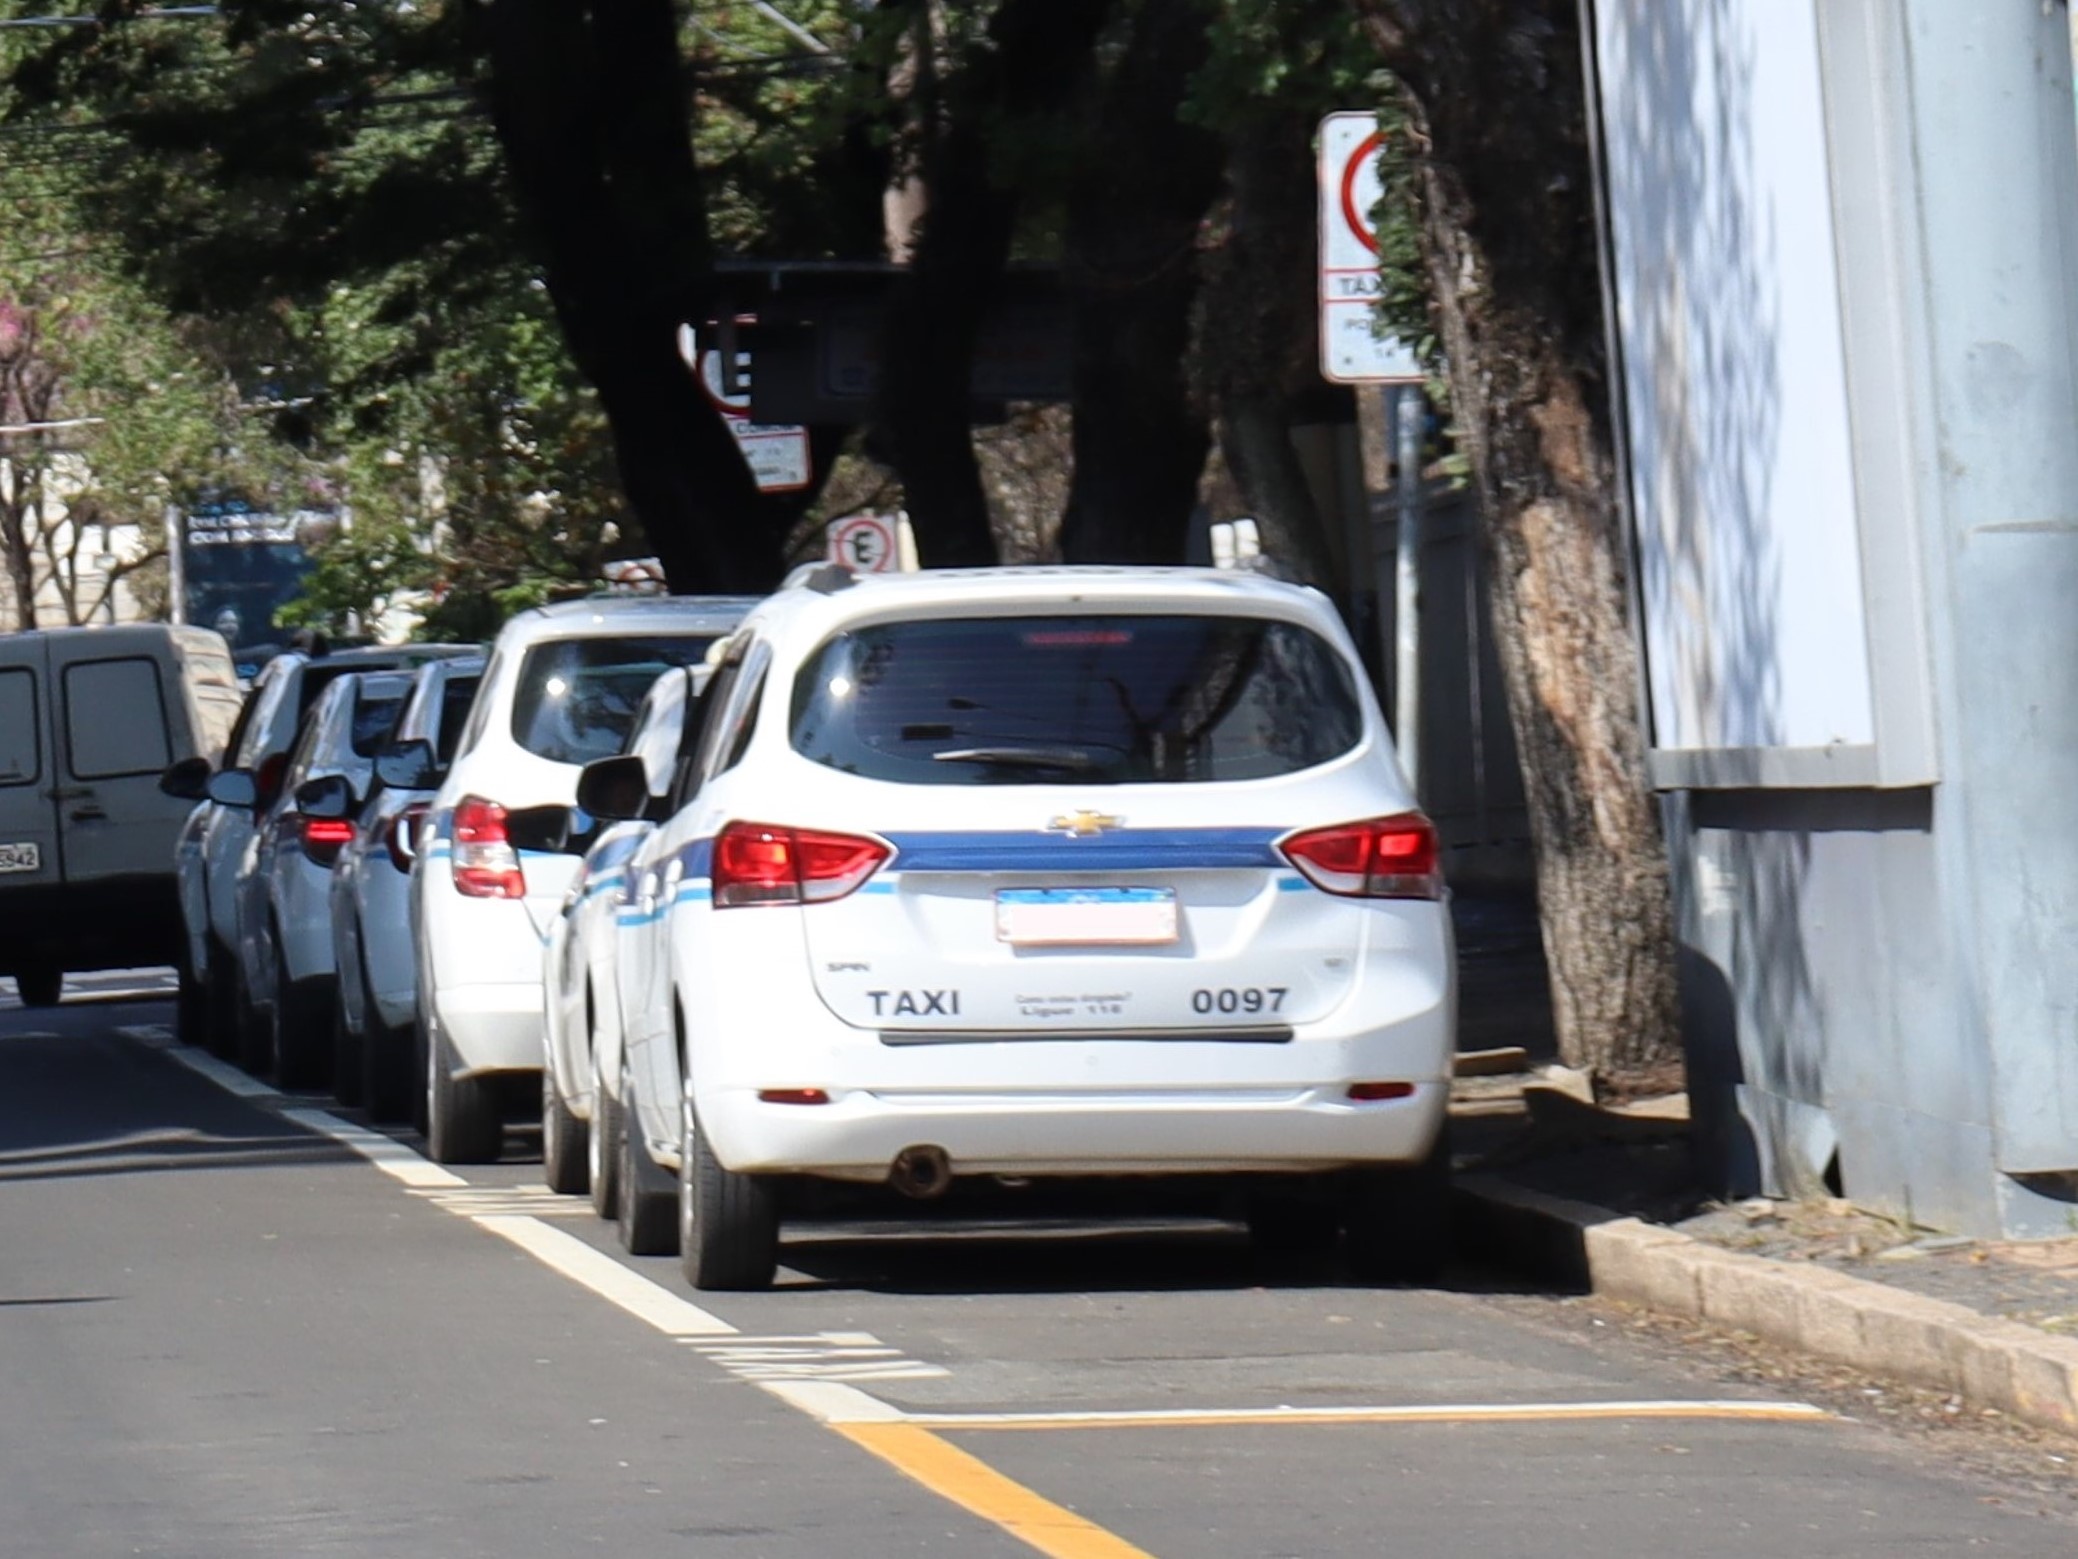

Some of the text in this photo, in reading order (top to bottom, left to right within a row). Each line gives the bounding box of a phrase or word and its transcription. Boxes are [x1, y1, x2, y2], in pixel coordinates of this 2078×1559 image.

[854, 531, 873, 563] E
[866, 989, 960, 1016] TAXI
[1021, 1005, 1076, 1018] Ligue
[1192, 988, 1289, 1014] 0097
